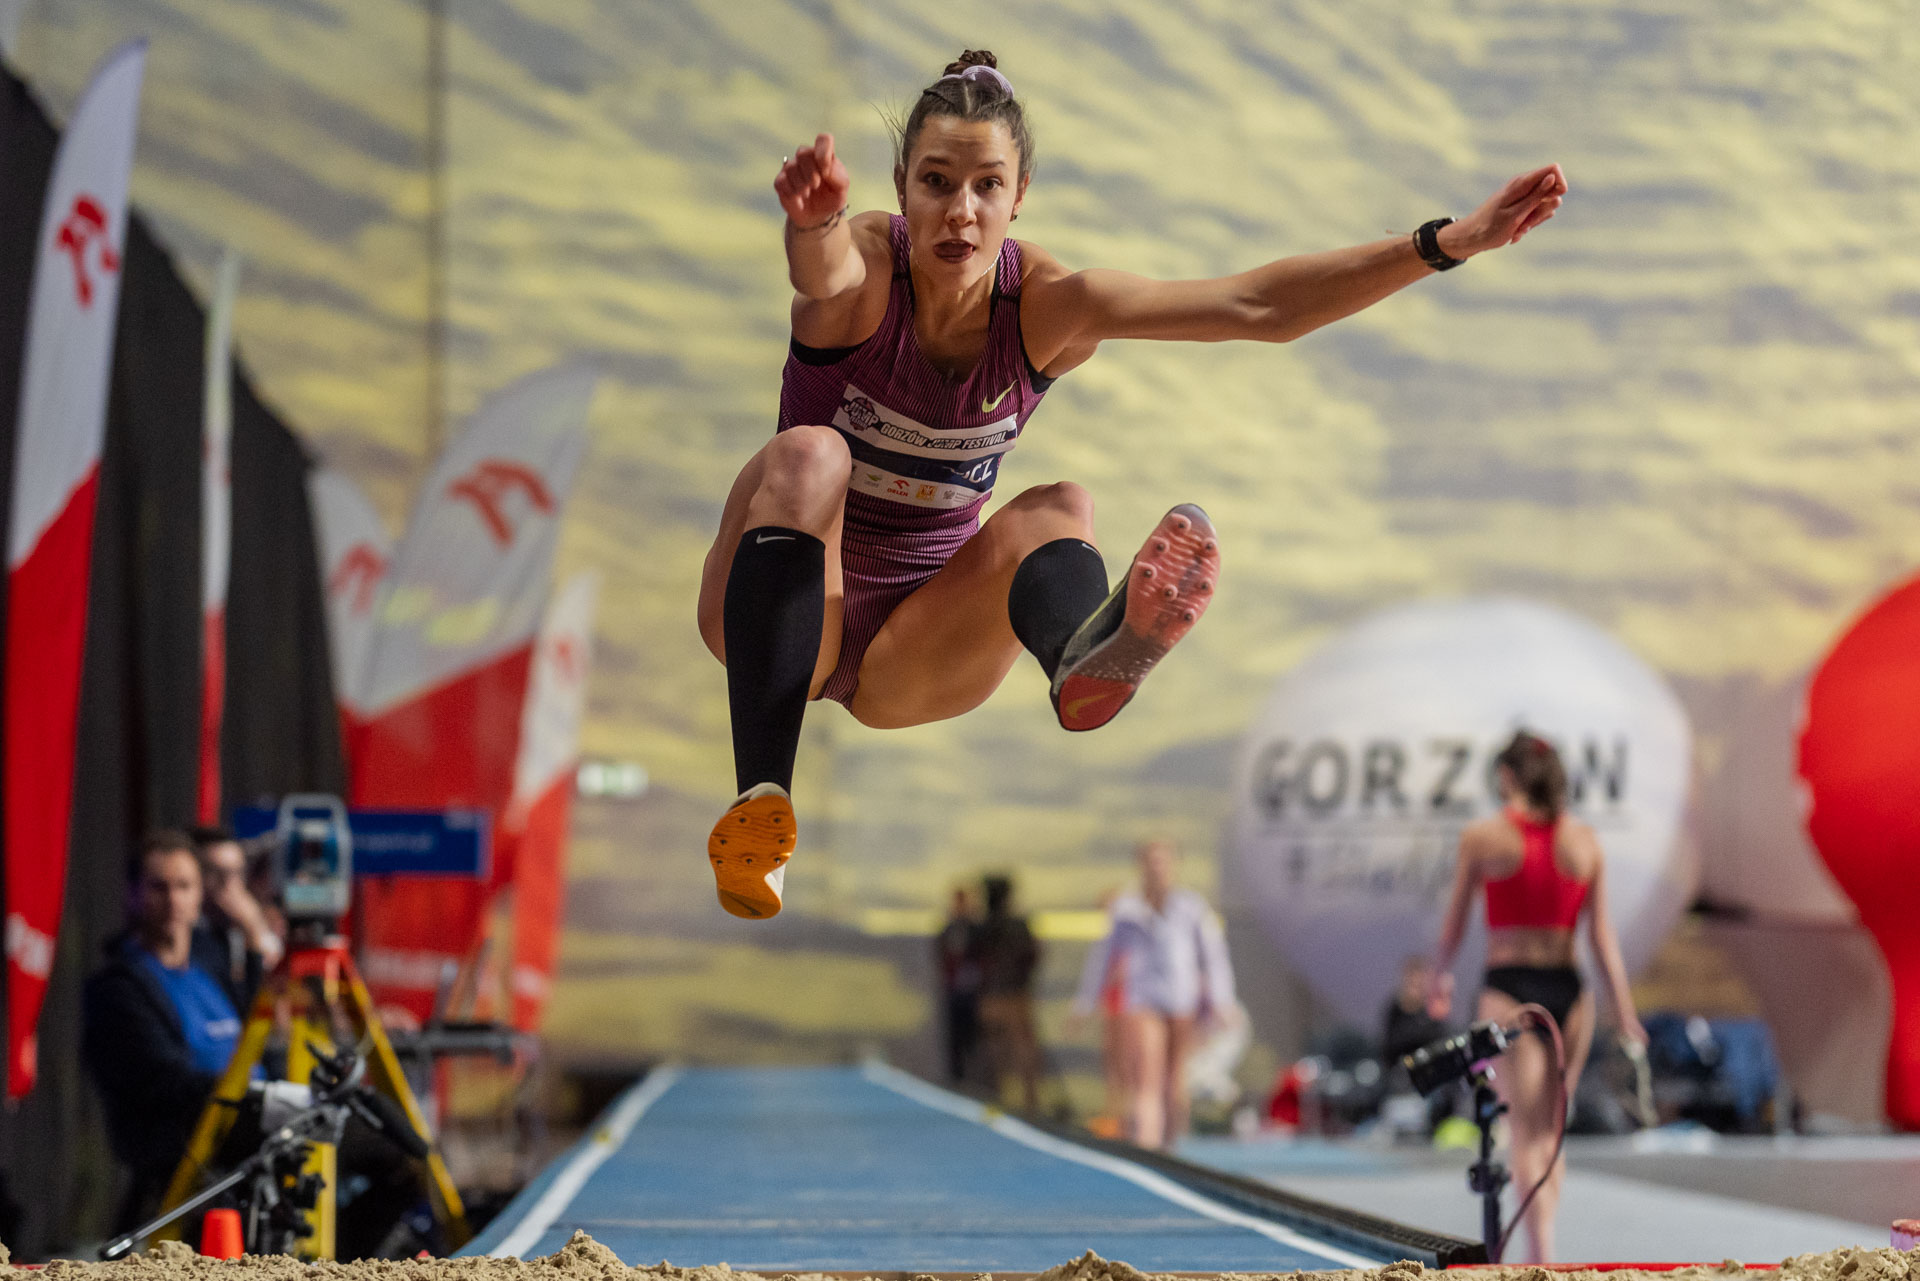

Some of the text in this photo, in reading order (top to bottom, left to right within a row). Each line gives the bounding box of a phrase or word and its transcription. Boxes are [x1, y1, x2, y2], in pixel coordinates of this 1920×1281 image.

[880, 422, 926, 447] GORZÓW
[961, 431, 1007, 450] FESTIVAL
[887, 487, 909, 497] ORLEN
[1251, 732, 1630, 820] GORZW
